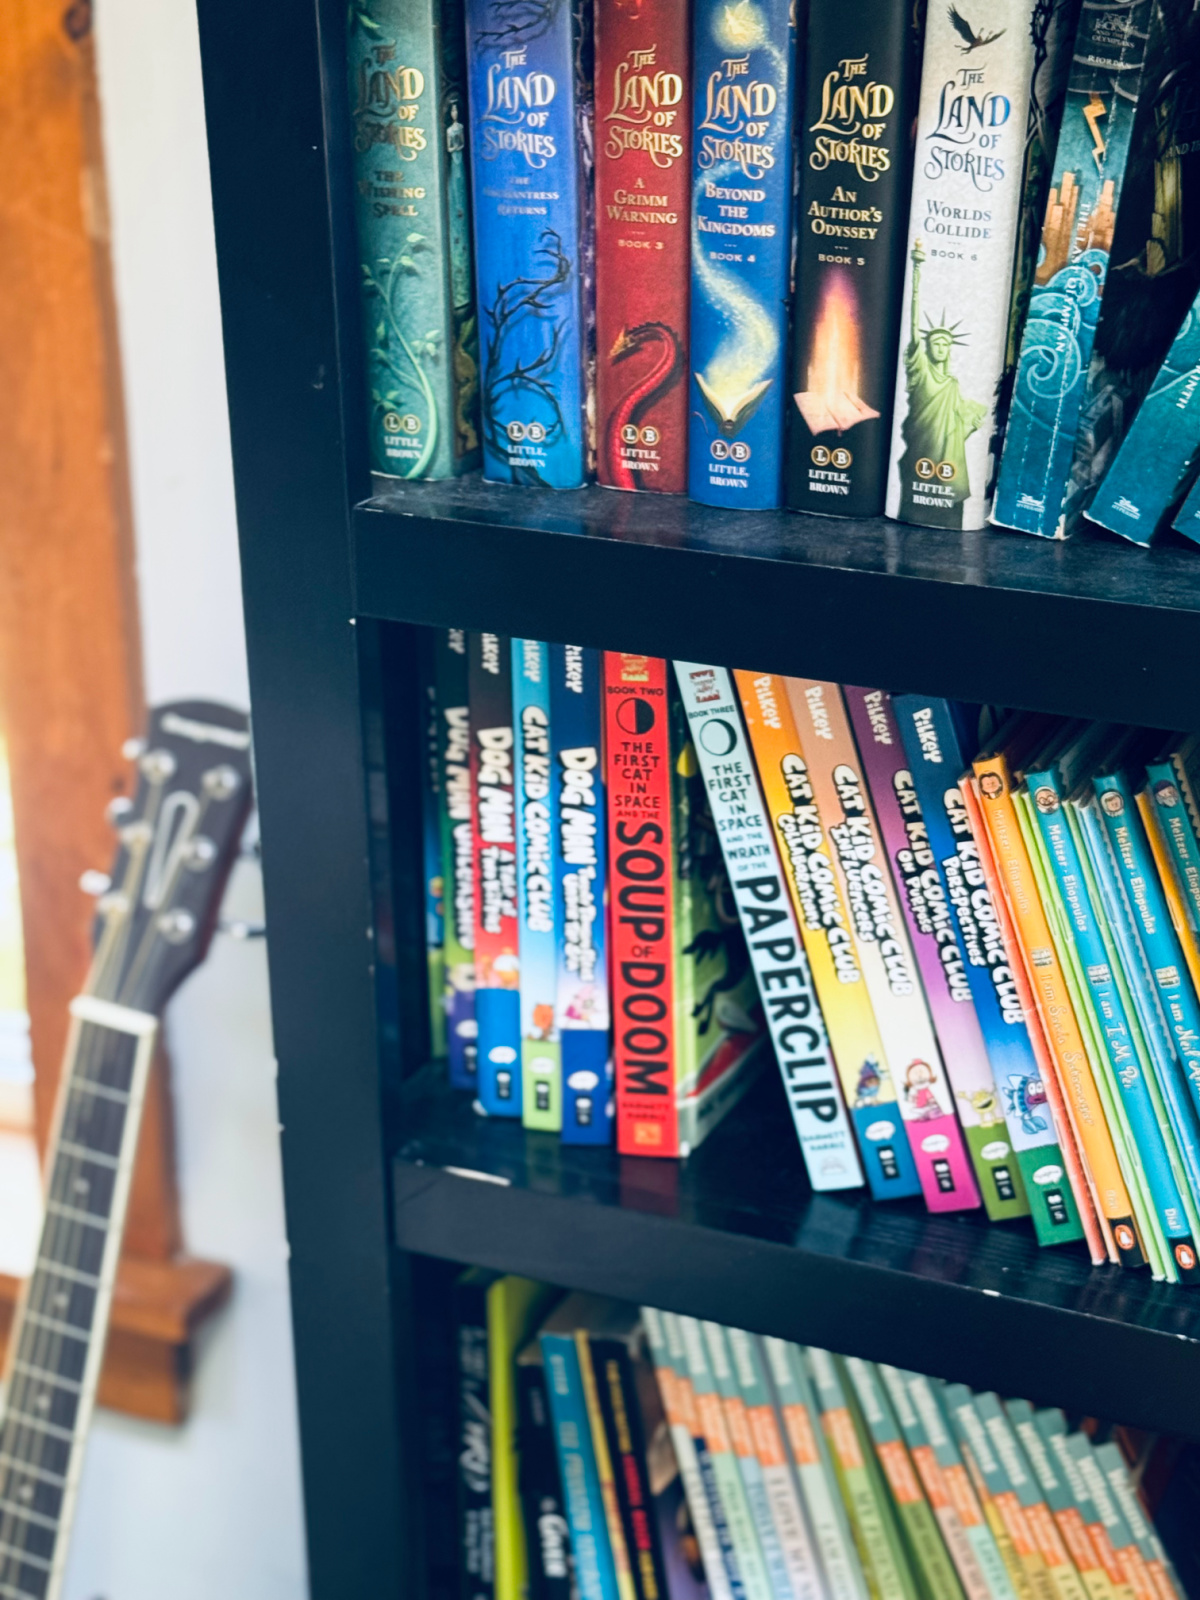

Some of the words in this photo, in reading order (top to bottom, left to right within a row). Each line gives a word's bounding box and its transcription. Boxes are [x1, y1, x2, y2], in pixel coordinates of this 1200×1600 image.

[501, 45, 527, 71] THE
[627, 44, 657, 72] THE
[721, 54, 750, 78] THE
[839, 53, 869, 81] THE
[956, 63, 987, 91] THE
[353, 58, 424, 117] LAND
[480, 64, 555, 124] LAND
[603, 63, 682, 124] LAND
[698, 71, 776, 134] LAND
[809, 71, 894, 136] LAND
[925, 80, 1011, 144] LAND
[398, 104, 419, 122] OF
[527, 112, 549, 128] OF
[654, 111, 677, 127] OF
[746, 121, 769, 138] OF
[862, 123, 886, 141] OF
[355, 121, 427, 161] STORIES
[480, 127, 557, 169] STORIES
[605, 125, 683, 168] STORIES
[979, 133, 1002, 150] OF
[698, 135, 775, 179] STORIES
[809, 135, 891, 182] STORIES
[924, 146, 1005, 193] STORIES
[634, 178, 645, 189] A
[705, 182, 766, 202] BEYOND
[614, 190, 668, 207] GRIMM
[831, 186, 857, 203] AN
[606, 205, 678, 224] WARNING
[718, 205, 749, 219] THE
[807, 200, 883, 223] AUTHOR'S
[926, 199, 992, 222] WORLDS
[1077, 202, 1092, 232] THE
[697, 215, 775, 238] KINGDOMS
[811, 219, 878, 240] ODYSSEY
[923, 217, 992, 239] COLLIDE
[618, 239, 650, 249] BOOK
[654, 241, 664, 250] 3
[710, 252, 742, 262] BOOK
[747, 254, 756, 263] 4
[818, 253, 852, 265] BOOK
[857, 257, 865, 266] 5
[931, 249, 964, 260] BOOK
[971, 253, 978, 261] 6
[386, 448, 420, 459] BROWN
[507, 444, 547, 457] LITTLE,
[621, 447, 661, 460] LITTLE,
[509, 457, 546, 467] BROWN
[622, 459, 659, 472] BROWN
[708, 463, 749, 477] LITTLE,
[710, 476, 748, 488] BROWN
[808, 469, 850, 484] LITTLE,
[809, 482, 848, 495] BROWN
[912, 481, 955, 496] LITTLE,
[913, 494, 952, 508] BROWN
[607, 686, 637, 694] BOOK
[641, 688, 664, 696] TWO
[688, 711, 709, 719] BOOK
[711, 705, 735, 715] THREE
[523, 705, 549, 753] CAT
[477, 726, 514, 786] DOG
[621, 742, 653, 753] THE
[614, 755, 660, 767] FIRST
[712, 762, 743, 776] THE
[559, 747, 597, 806] DOG
[622, 769, 652, 780] CAT
[708, 774, 751, 790] FIRST
[630, 783, 646, 793] IN
[719, 789, 747, 802] CAT
[615, 795, 660, 808] SPACE
[730, 803, 746, 815] IN
[478, 786, 515, 843] MAN
[616, 810, 637, 818] AND
[718, 815, 763, 832] SPACE
[560, 807, 598, 865] MAN
[727, 833, 745, 843] AND
[746, 831, 763, 841] THE
[993, 809, 1011, 851] Meltzer
[1168, 817, 1189, 859] Meltzer
[726, 844, 772, 860] WRATH
[898, 850, 916, 873] ON
[737, 864, 747, 872] OF
[750, 861, 768, 870] THE
[781, 753, 813, 803] CAT
[828, 927, 861, 985] CLUB
[615, 822, 665, 942] SOUP
[833, 764, 865, 815] CAT
[881, 939, 915, 996] CLUB
[894, 770, 922, 820] CAT
[941, 945, 974, 1002] CLUB
[1048, 824, 1067, 867] Meltzer
[1062, 873, 1088, 932] Eliopoulos
[1114, 827, 1134, 870] Meltzer
[1130, 877, 1156, 935] Eliopoulos
[526, 875, 554, 933] CLUB
[944, 788, 972, 834] CAT
[992, 966, 1025, 1025] CLUB
[631, 945, 655, 958] OF
[735, 875, 839, 1123] PAPERCLIP
[1044, 984, 1055, 1001] am
[1101, 1000, 1113, 1018] am
[1170, 1002, 1183, 1021] am
[621, 961, 668, 1096] DOOM
[1105, 1022, 1127, 1039] I
[1111, 1040, 1132, 1063] M
[1119, 1066, 1138, 1088] Pei
[1164, 1208, 1181, 1230] Dial
